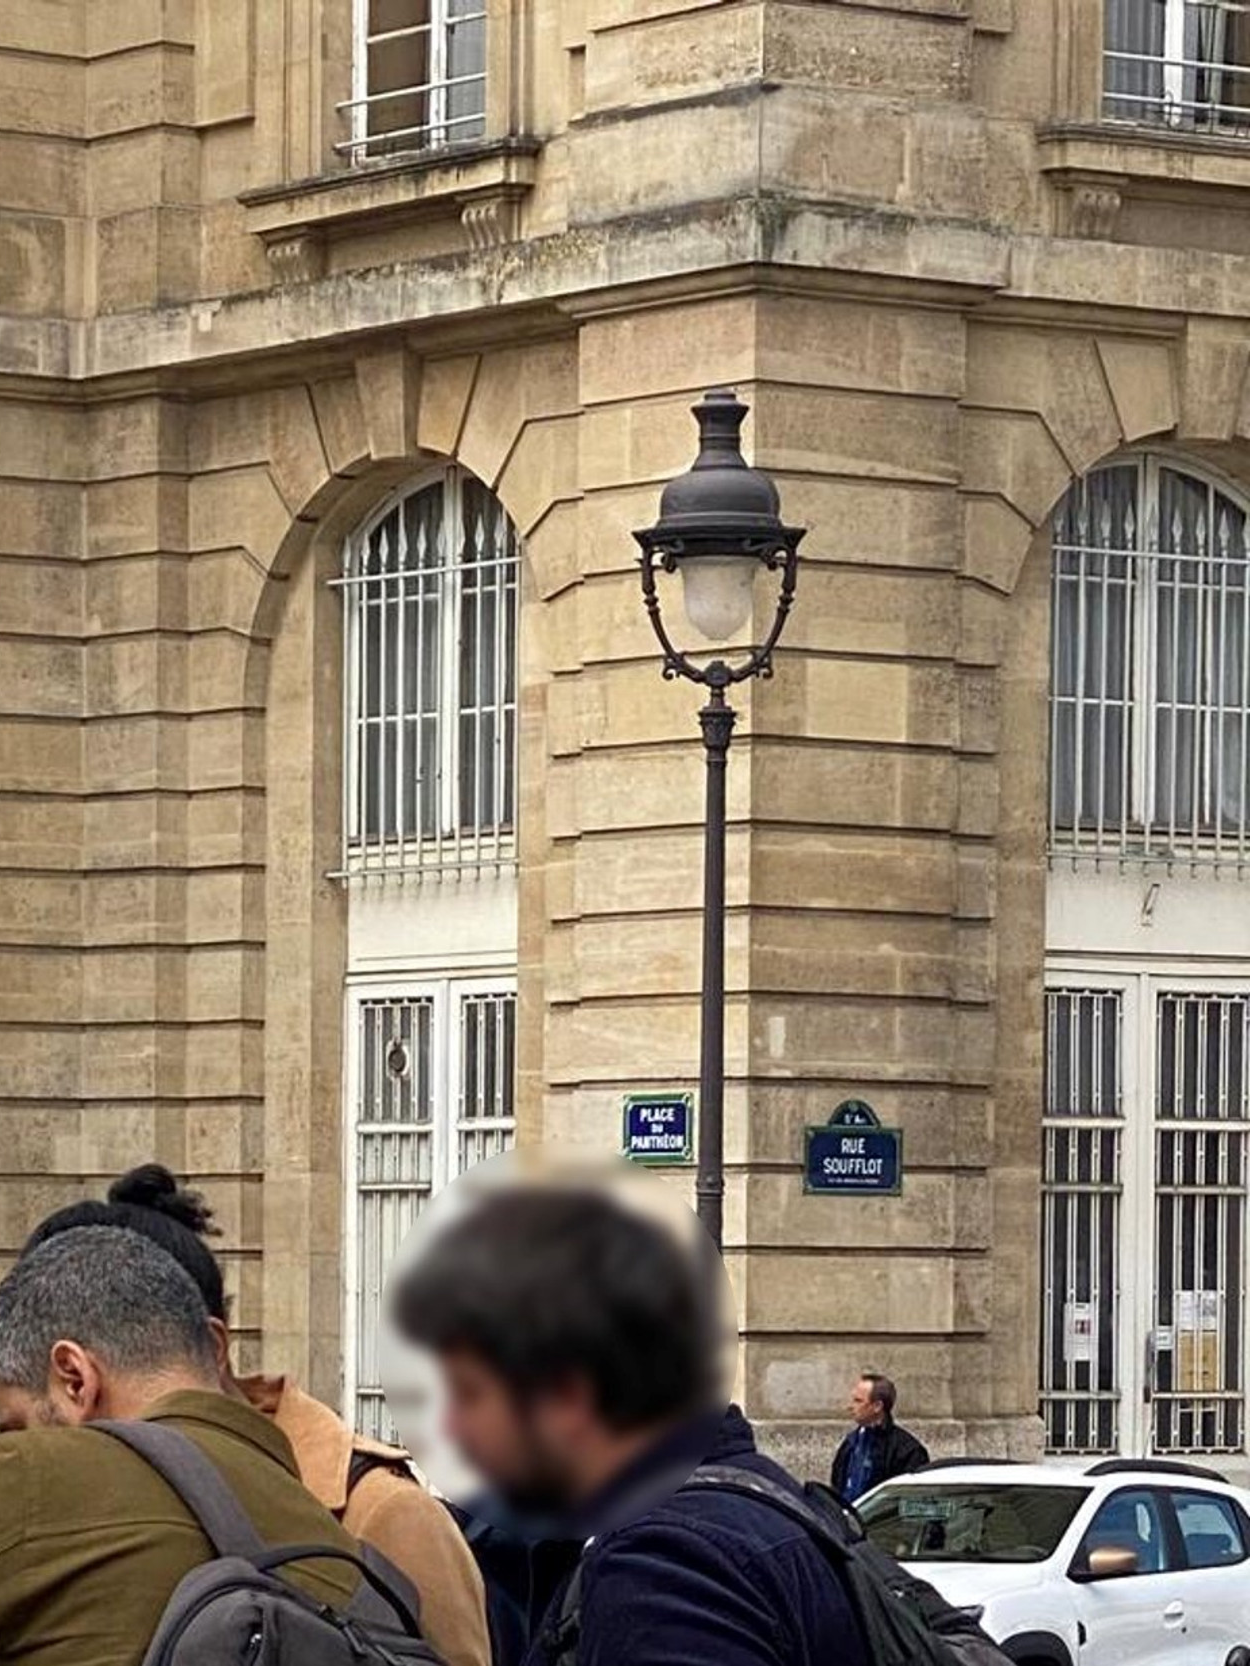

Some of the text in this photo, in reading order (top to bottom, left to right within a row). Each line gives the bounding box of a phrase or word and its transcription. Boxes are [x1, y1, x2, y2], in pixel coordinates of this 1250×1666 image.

[639, 1107, 675, 1122] PLACE
[651, 1123, 664, 1133] DU
[631, 1132, 684, 1149] PANTHÉON
[841, 1137, 866, 1154] RUE
[823, 1156, 883, 1175] SOUFFLOT
